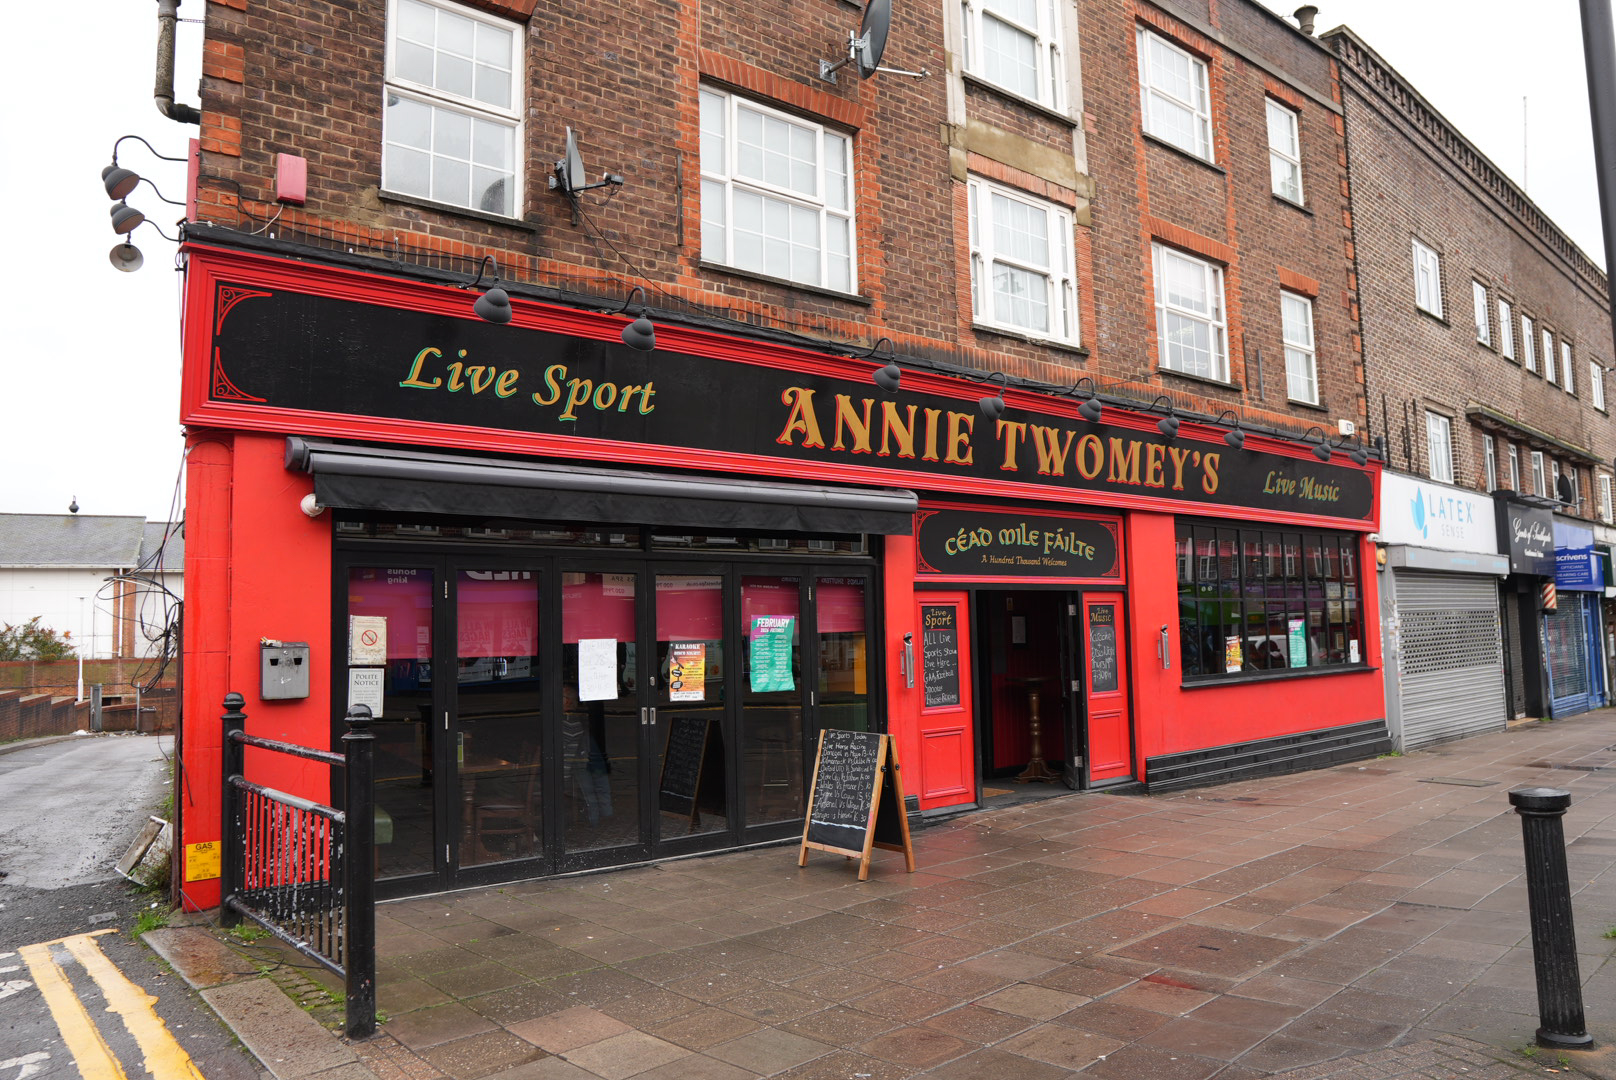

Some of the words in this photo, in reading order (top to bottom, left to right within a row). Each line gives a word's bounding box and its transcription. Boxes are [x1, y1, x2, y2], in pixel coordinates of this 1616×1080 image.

[399, 346, 519, 398] Live
[532, 363, 657, 422] Sport
[776, 386, 976, 467] ANNIE
[996, 418, 1221, 496] TWOMEY'S
[1262, 469, 1296, 496] Live
[1299, 476, 1341, 503] Music
[1428, 493, 1473, 523] LATEX
[1441, 524, 1465, 539] SENSE
[981, 554, 988, 563] A
[989, 555, 1015, 565] Hundred
[1015, 556, 1041, 566] Thousand
[1041, 557, 1068, 567] Welcomes
[1556, 553, 1588, 562] scrivens
[931, 608, 947, 616] Live
[1091, 613, 1112, 622] Music
[756, 618, 790, 628] FEBRUARY
[925, 614, 952, 629] Sport
[939, 632, 951, 643] Live
[924, 645, 943, 659] Sports
[195, 843, 213, 851] GAS
